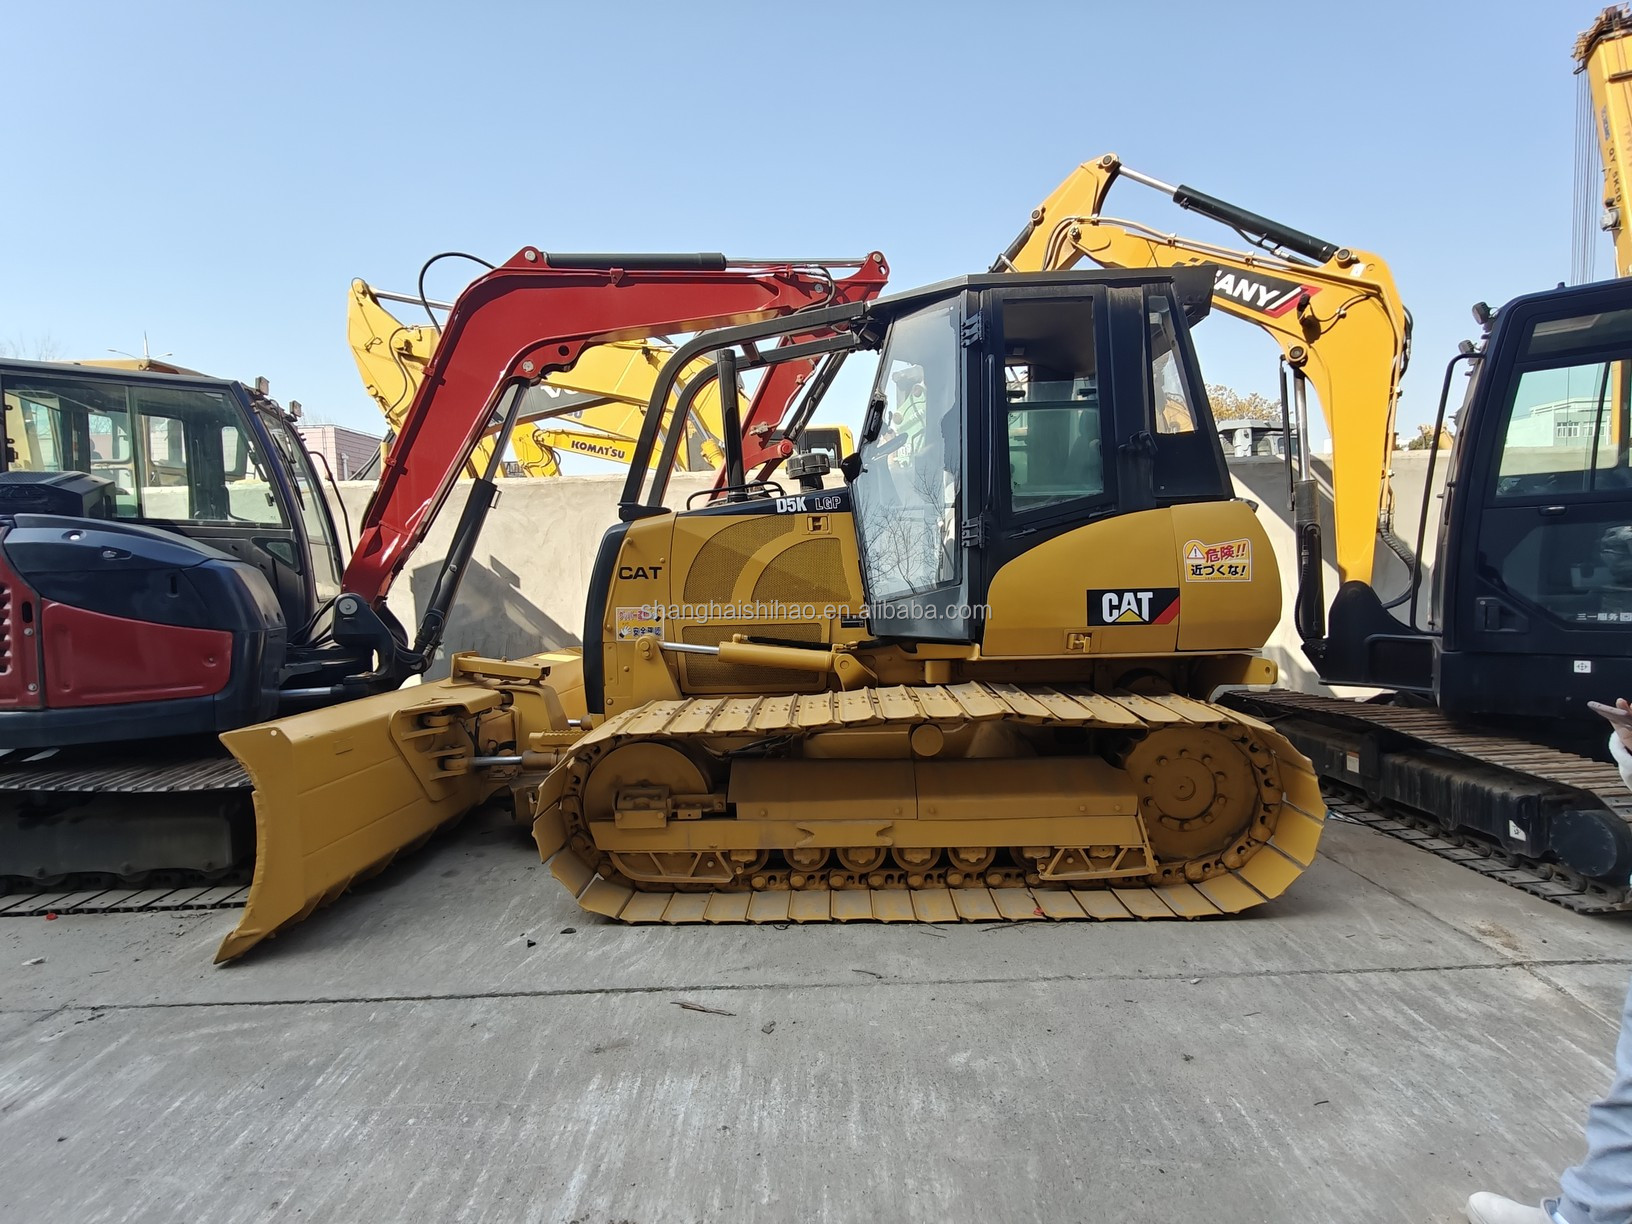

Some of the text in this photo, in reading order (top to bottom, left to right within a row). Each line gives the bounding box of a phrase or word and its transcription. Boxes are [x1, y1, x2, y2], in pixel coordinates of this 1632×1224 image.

[1213, 269, 1281, 308] ANY
[571, 440, 625, 459] KOMATSU
[775, 496, 842, 513] D5K LGP
[618, 566, 663, 580] CAT
[1101, 592, 1153, 623] CAT
